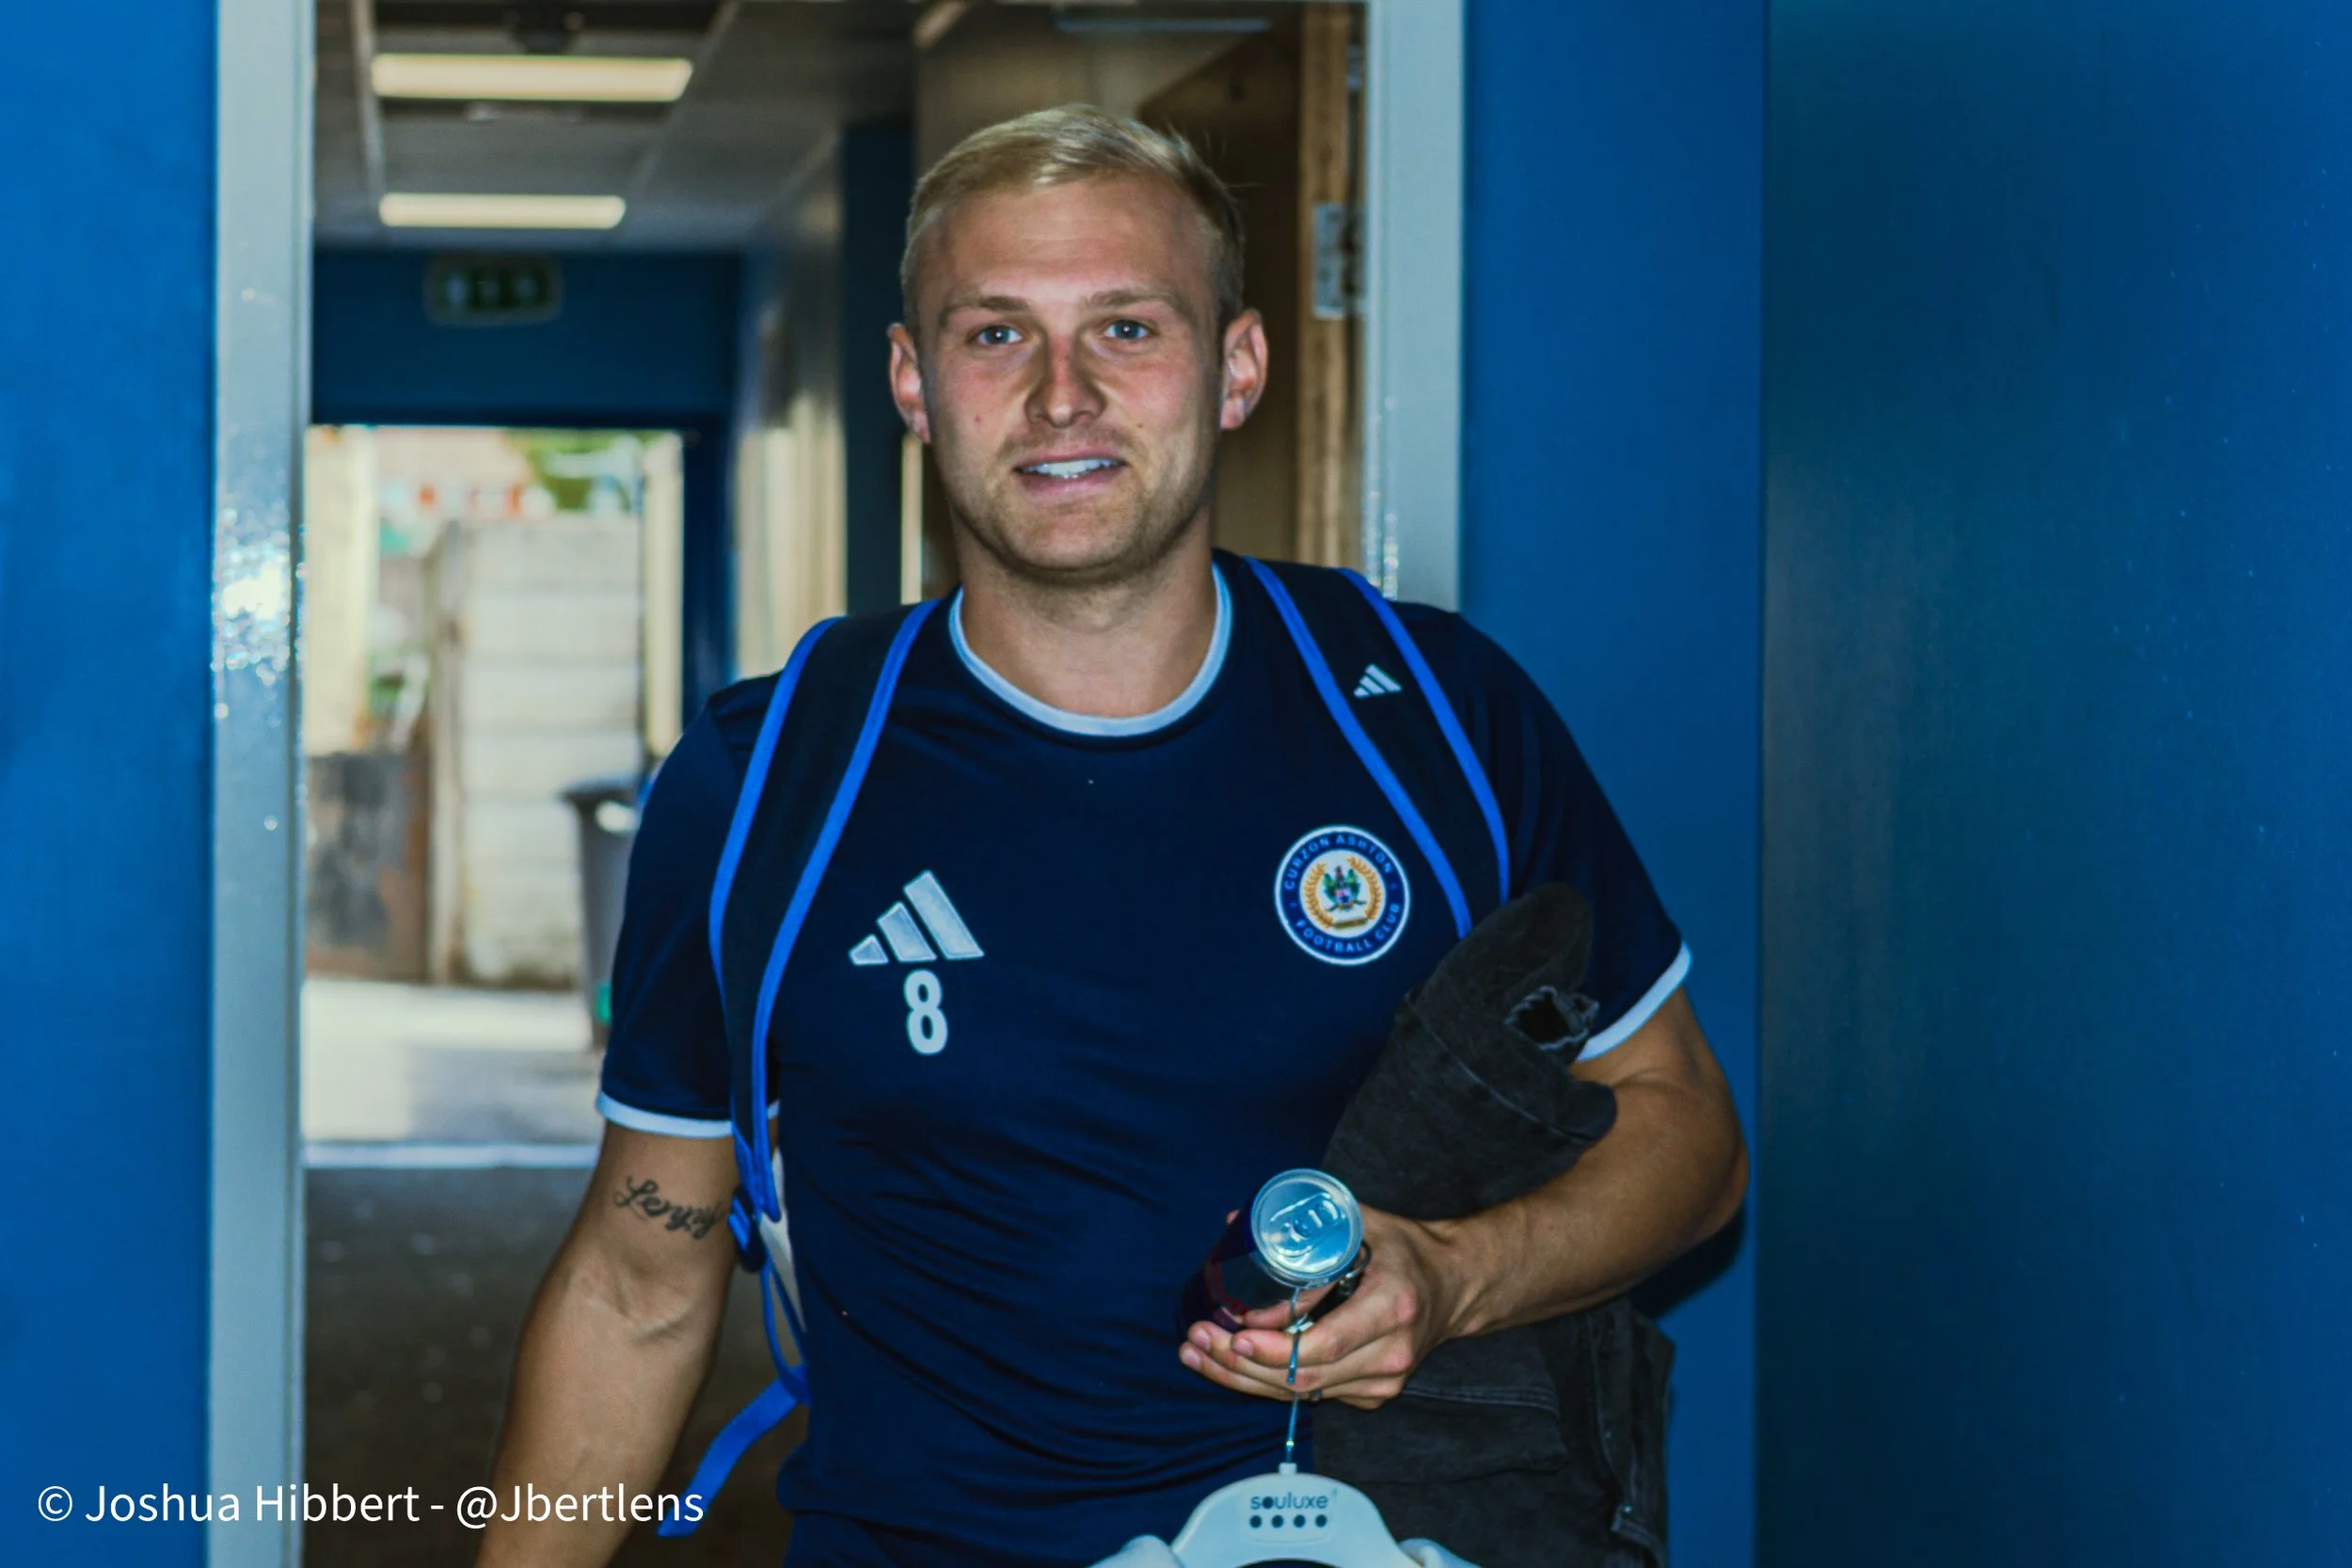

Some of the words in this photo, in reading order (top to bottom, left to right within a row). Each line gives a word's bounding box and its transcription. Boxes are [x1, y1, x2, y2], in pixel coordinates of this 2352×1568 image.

[1284, 836, 1329, 890] CURZON
[1336, 834, 1393, 873] ASHTON
[1295, 918, 1373, 953] FOOTBALL
[1375, 902, 1400, 941] CLUB
[904, 969, 948, 1055] 8
[1250, 1491, 1328, 1510] souluxe
